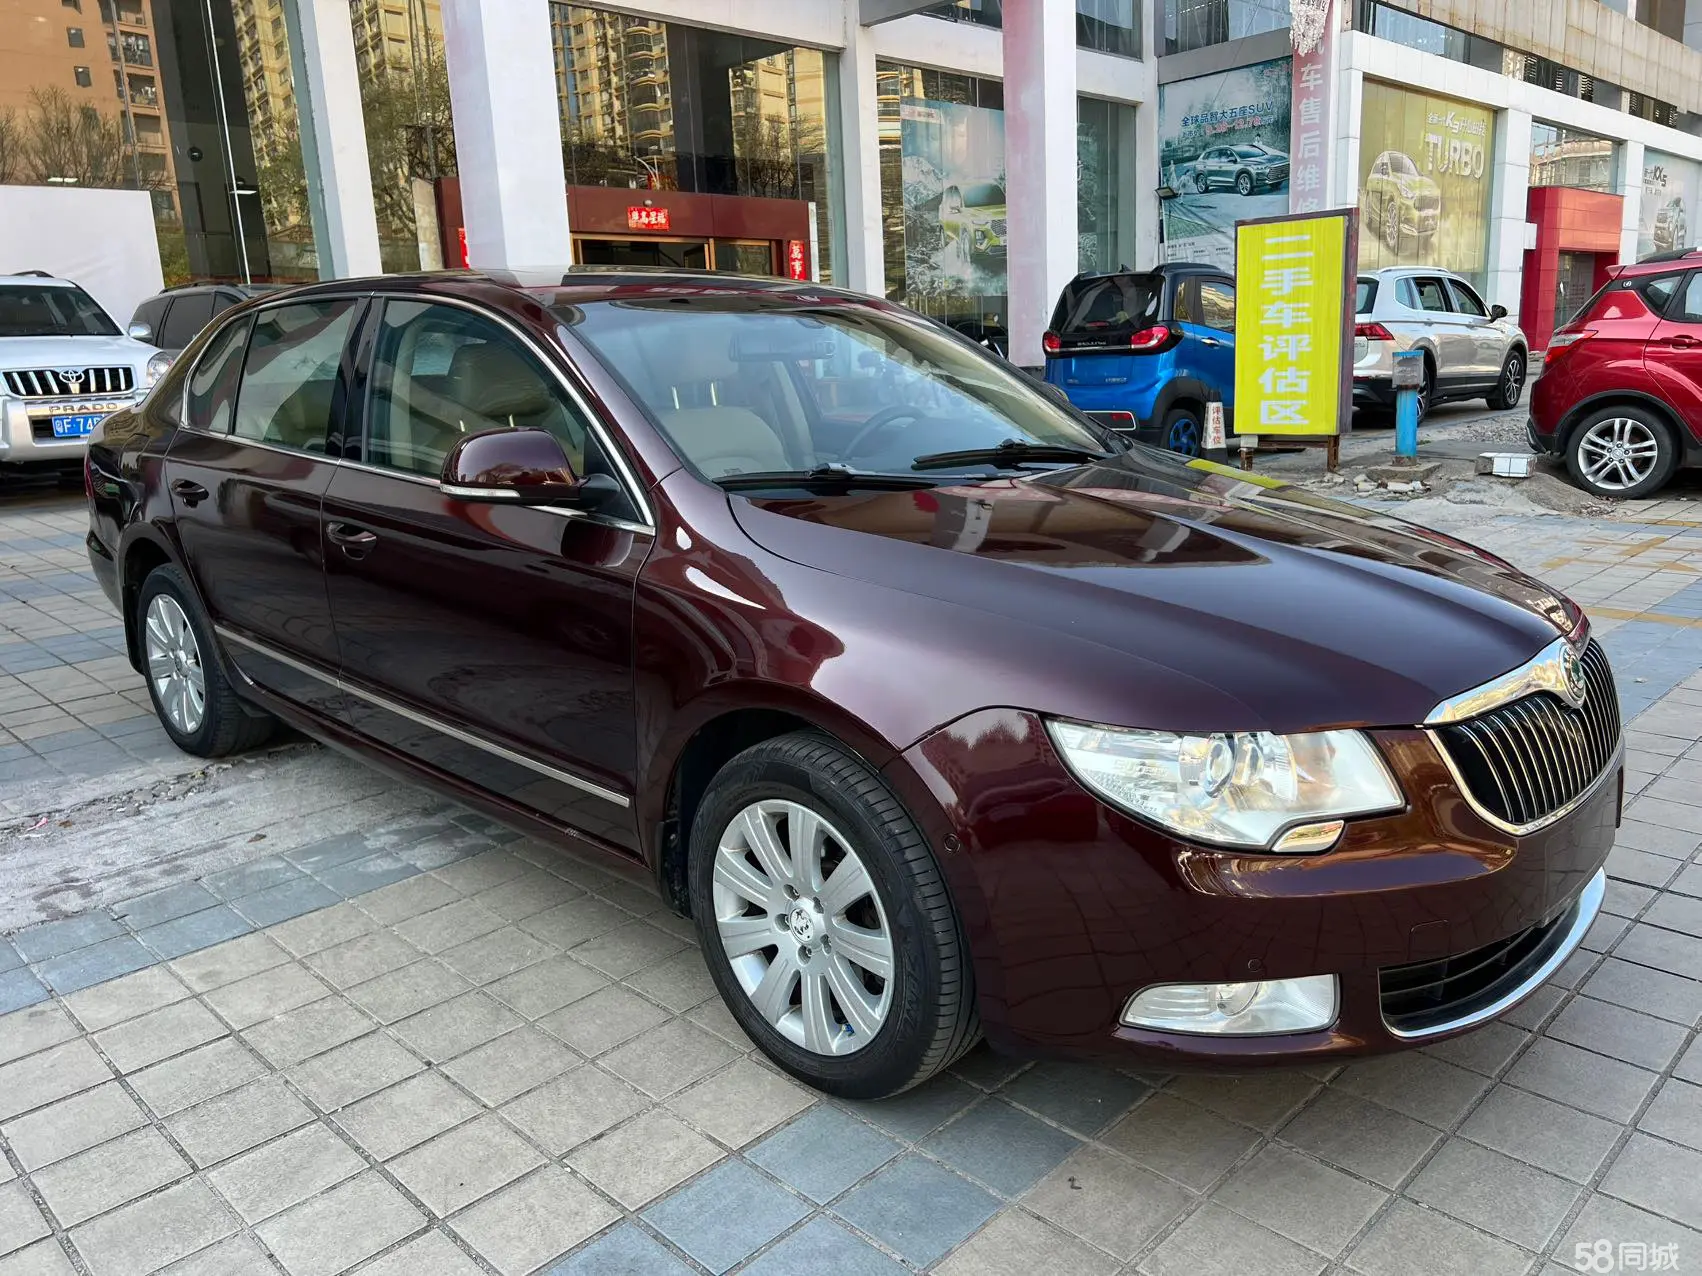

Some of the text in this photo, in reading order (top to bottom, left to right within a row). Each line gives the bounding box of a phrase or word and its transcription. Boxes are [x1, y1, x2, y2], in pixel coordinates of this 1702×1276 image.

[1425, 133, 1484, 178] TURBO
[1258, 234, 1314, 425] 二手车评估区
[48, 402, 118, 413] PRADO
